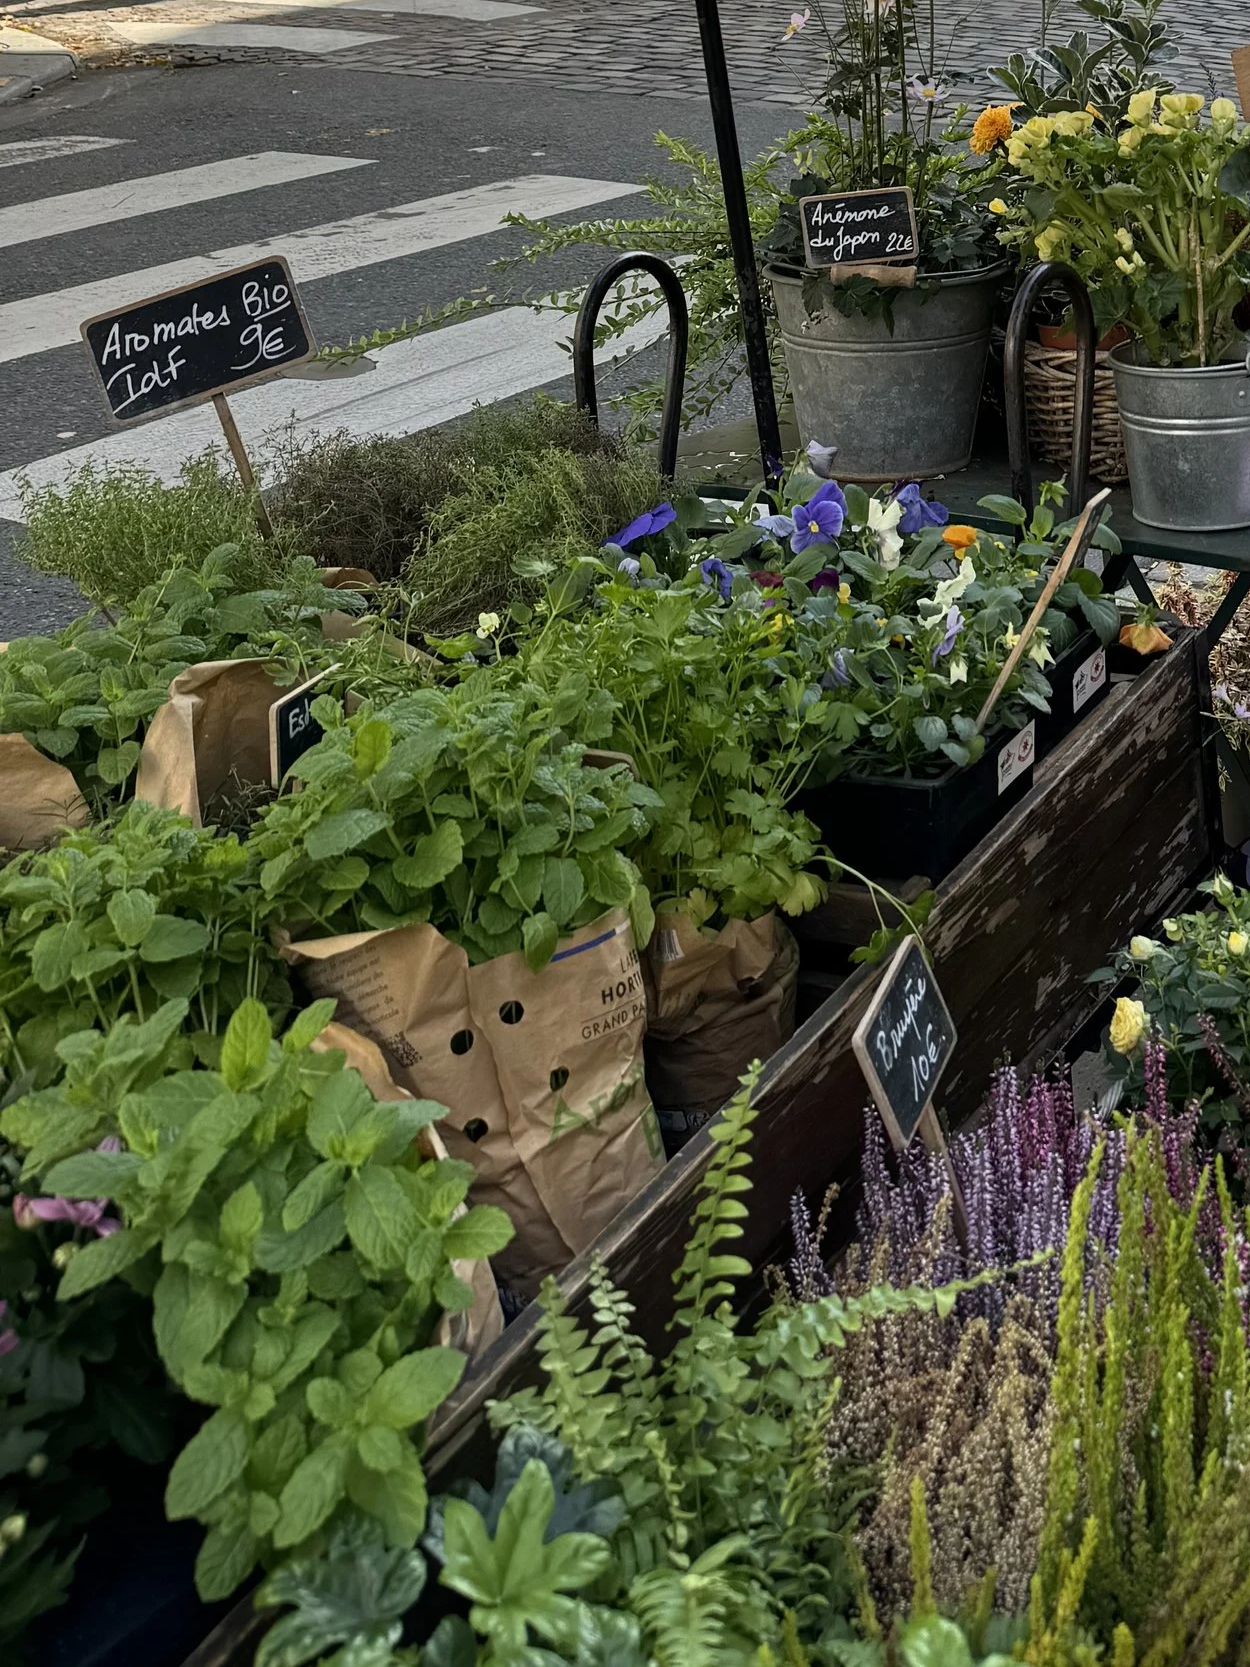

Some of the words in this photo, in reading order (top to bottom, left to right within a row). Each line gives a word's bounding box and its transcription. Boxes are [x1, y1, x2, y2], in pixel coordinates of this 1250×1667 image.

[811, 201, 896, 226] Anémone
[810, 229, 835, 247] du
[833, 226, 880, 261] Japon
[885, 232, 914, 253] 22€
[101, 302, 232, 366] Aromates
[241, 273, 289, 317] Bio
[230, 323, 297, 371] 9€
[581, 1008, 629, 1041] GRAND
[876, 976, 927, 1072] Bruyère
